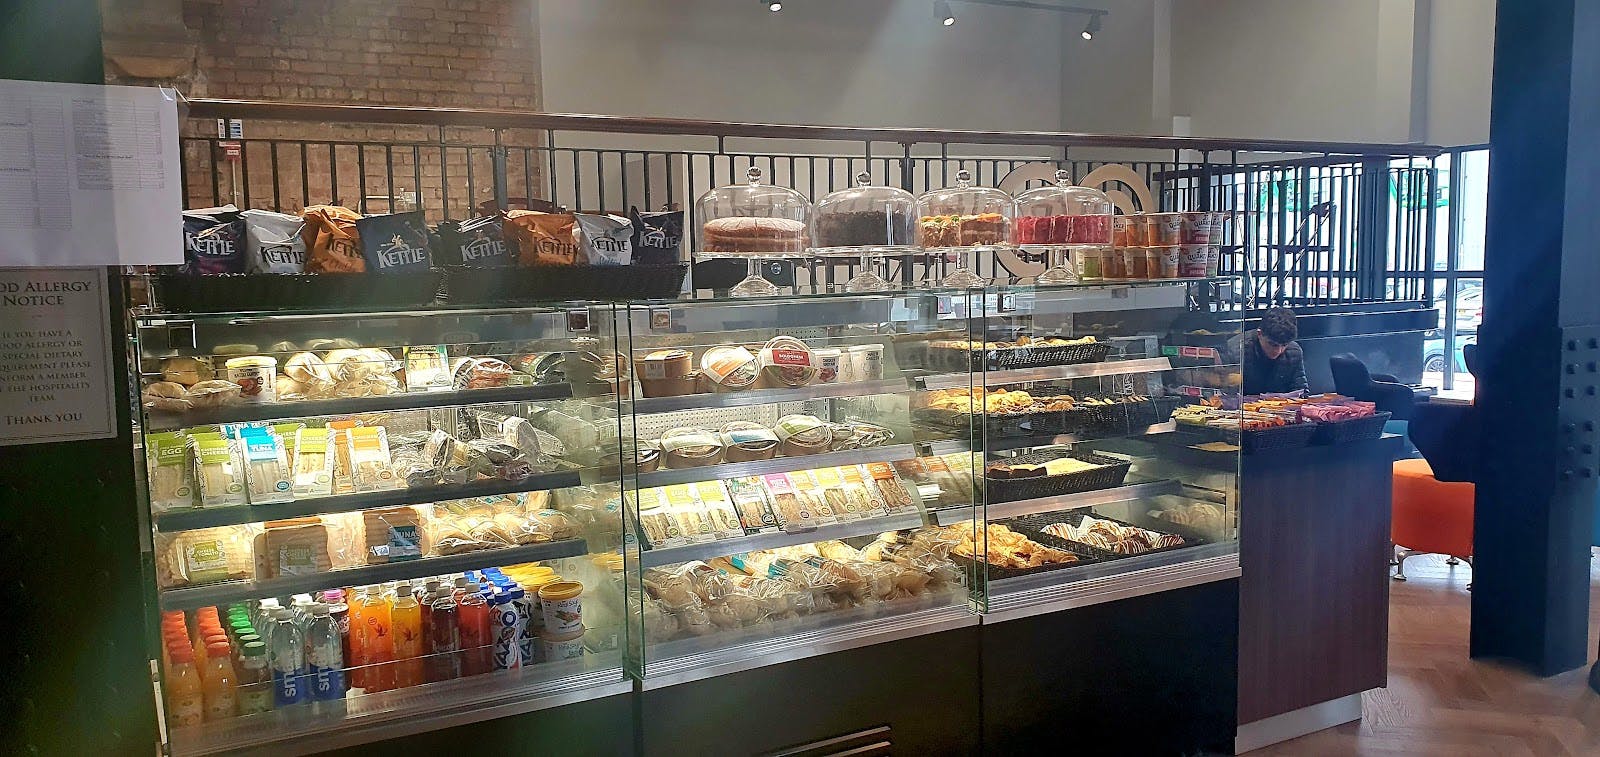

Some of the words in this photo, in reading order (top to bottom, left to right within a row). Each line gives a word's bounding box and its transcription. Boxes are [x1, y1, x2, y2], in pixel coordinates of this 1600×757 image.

[186, 231, 235, 255] KETTLE
[590, 236, 629, 253] KETTLE
[636, 231, 679, 250] KETTLE
[460, 236, 507, 262] KETTLE
[376, 245, 427, 268] KETTLE
[25, 281, 92, 293] ALLERGY
[3, 295, 65, 307] NOTICE
[15, 331, 35, 339] YOU
[39, 330, 65, 338] HAVE
[65, 330, 73, 338] A
[25, 341, 66, 349] ALLERGY
[69, 340, 83, 348] OR
[2, 352, 42, 361] SPECIAL
[44, 351, 83, 360] DIETARY
[60, 360, 92, 369] PLEASE
[38, 372, 46, 381] A
[47, 371, 87, 381] MEMBER
[29, 381, 91, 392] HOSPITALITY
[5, 415, 52, 426] THANK
[55, 412, 82, 423] YOU
[161, 447, 182, 456] EGG
